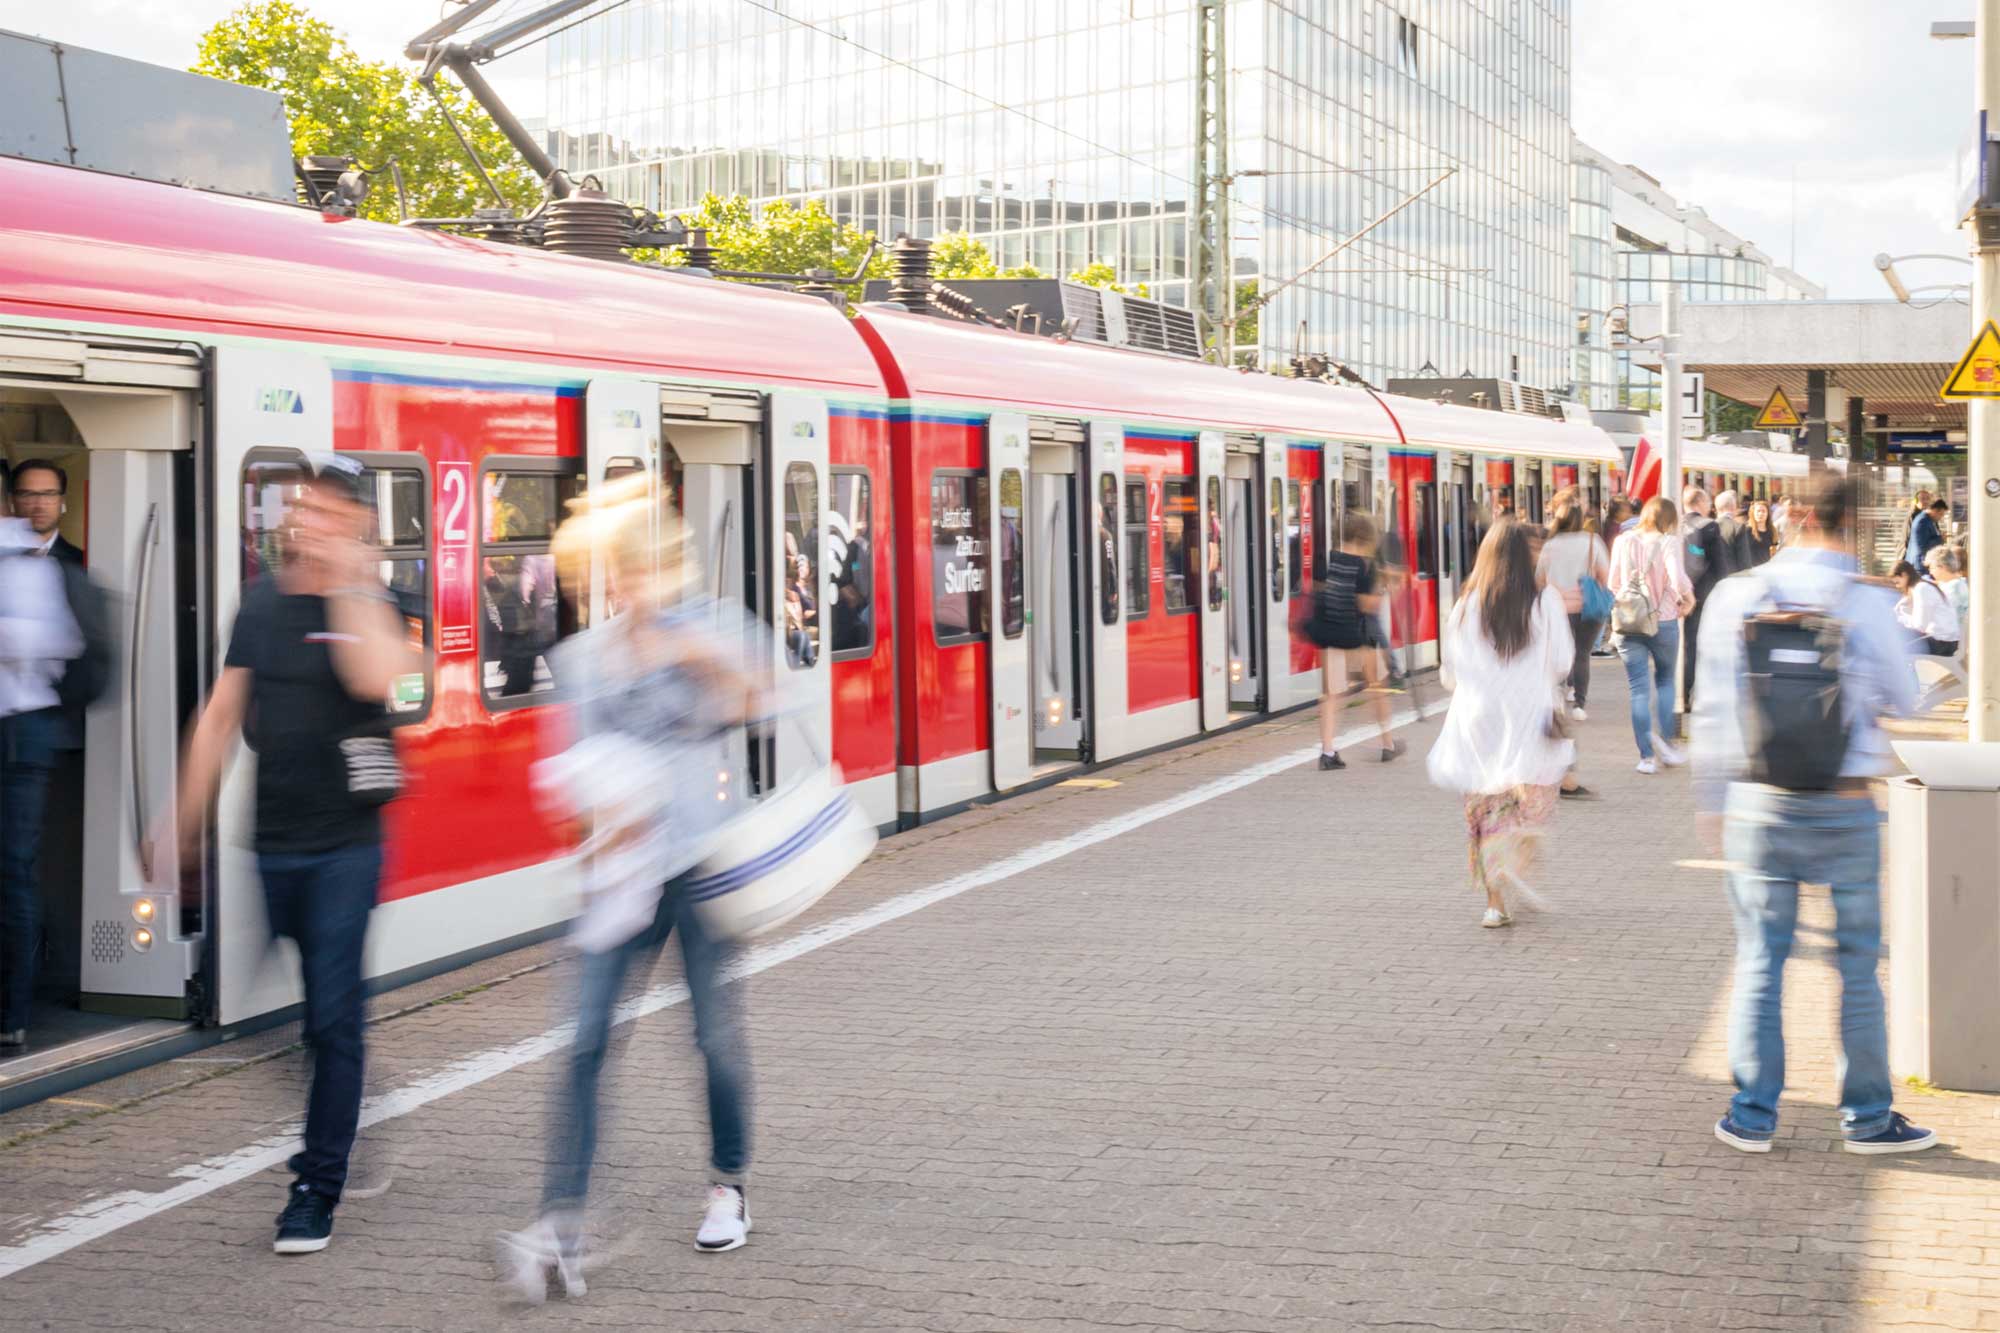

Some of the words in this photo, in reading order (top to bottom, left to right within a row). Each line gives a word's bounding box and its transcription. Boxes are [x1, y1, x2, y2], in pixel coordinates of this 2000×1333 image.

[442, 468, 466, 541] 2
[1150, 481, 1161, 522] 2
[955, 534, 973, 557] Zeit
